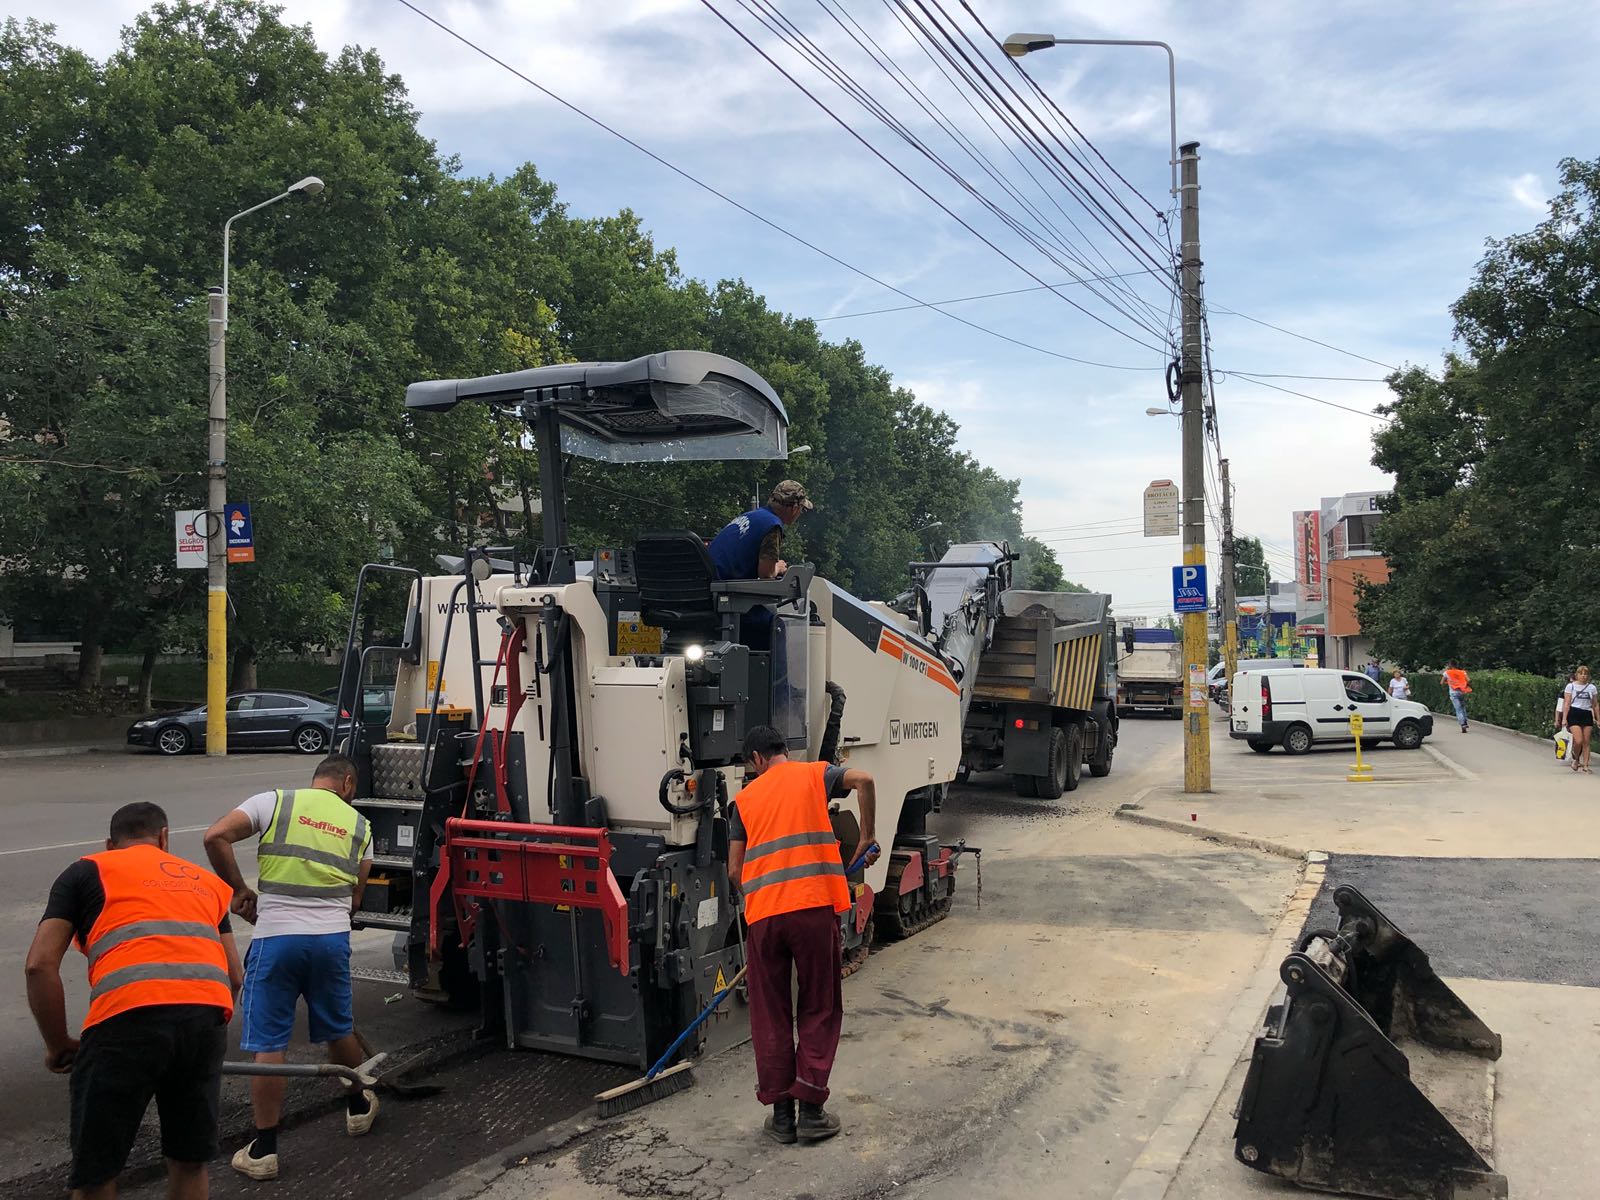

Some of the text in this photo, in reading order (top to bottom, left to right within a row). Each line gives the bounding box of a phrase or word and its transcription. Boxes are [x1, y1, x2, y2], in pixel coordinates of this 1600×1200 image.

[1182, 567, 1198, 588] P
[902, 652, 909, 665] W
[909, 655, 918, 671] 100
[902, 722, 939, 740] WIRTGEN
[298, 815, 348, 836] Staffline
